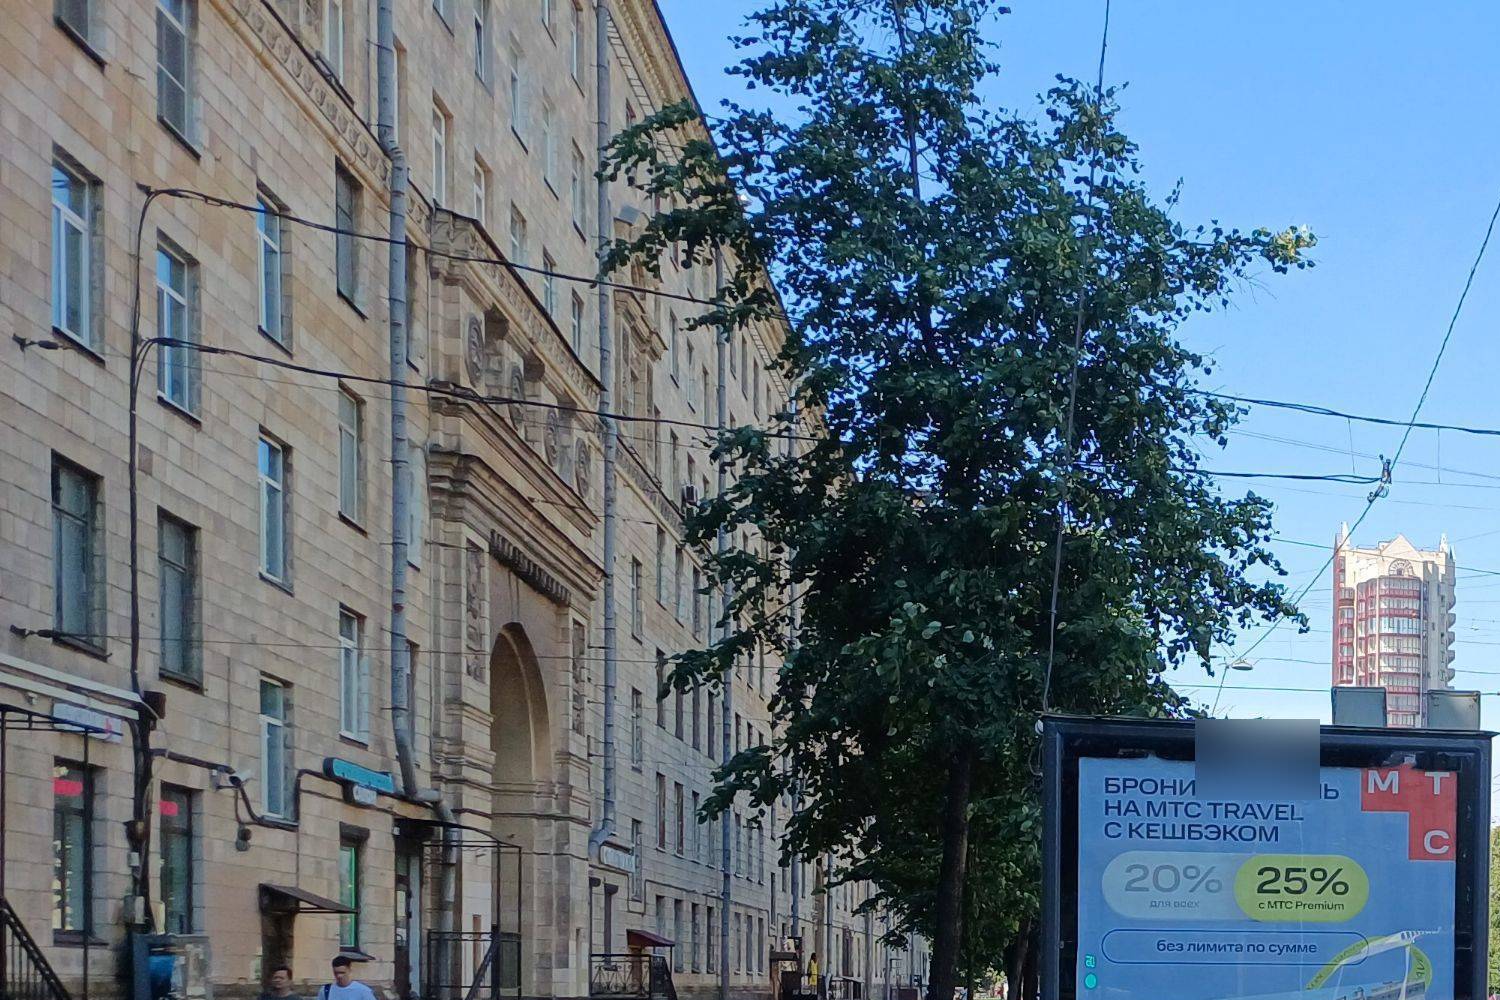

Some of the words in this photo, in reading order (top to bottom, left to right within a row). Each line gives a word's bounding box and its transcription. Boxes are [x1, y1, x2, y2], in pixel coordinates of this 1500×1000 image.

[1104, 777, 1196, 796] БРОНИ
[1367, 770, 1399, 794] М
[1424, 771, 1450, 795] Т
[1104, 799, 1142, 817] НА
[1146, 800, 1202, 818] МТС
[1206, 802, 1304, 821] TRAVEL
[1104, 821, 1122, 839] С
[1128, 822, 1279, 842] КЕШБЭКОМ
[1423, 829, 1450, 855] С
[1124, 863, 1223, 893] 20%
[1256, 866, 1350, 896] 25%
[1150, 900, 1171, 908] для
[1267, 901, 1294, 910] МТС
[1295, 901, 1345, 911] Premium
[1156, 939, 1184, 952] без
[1187, 941, 1243, 953] лимита
[1246, 943, 1265, 954] по
[1268, 943, 1318, 956] сумме
